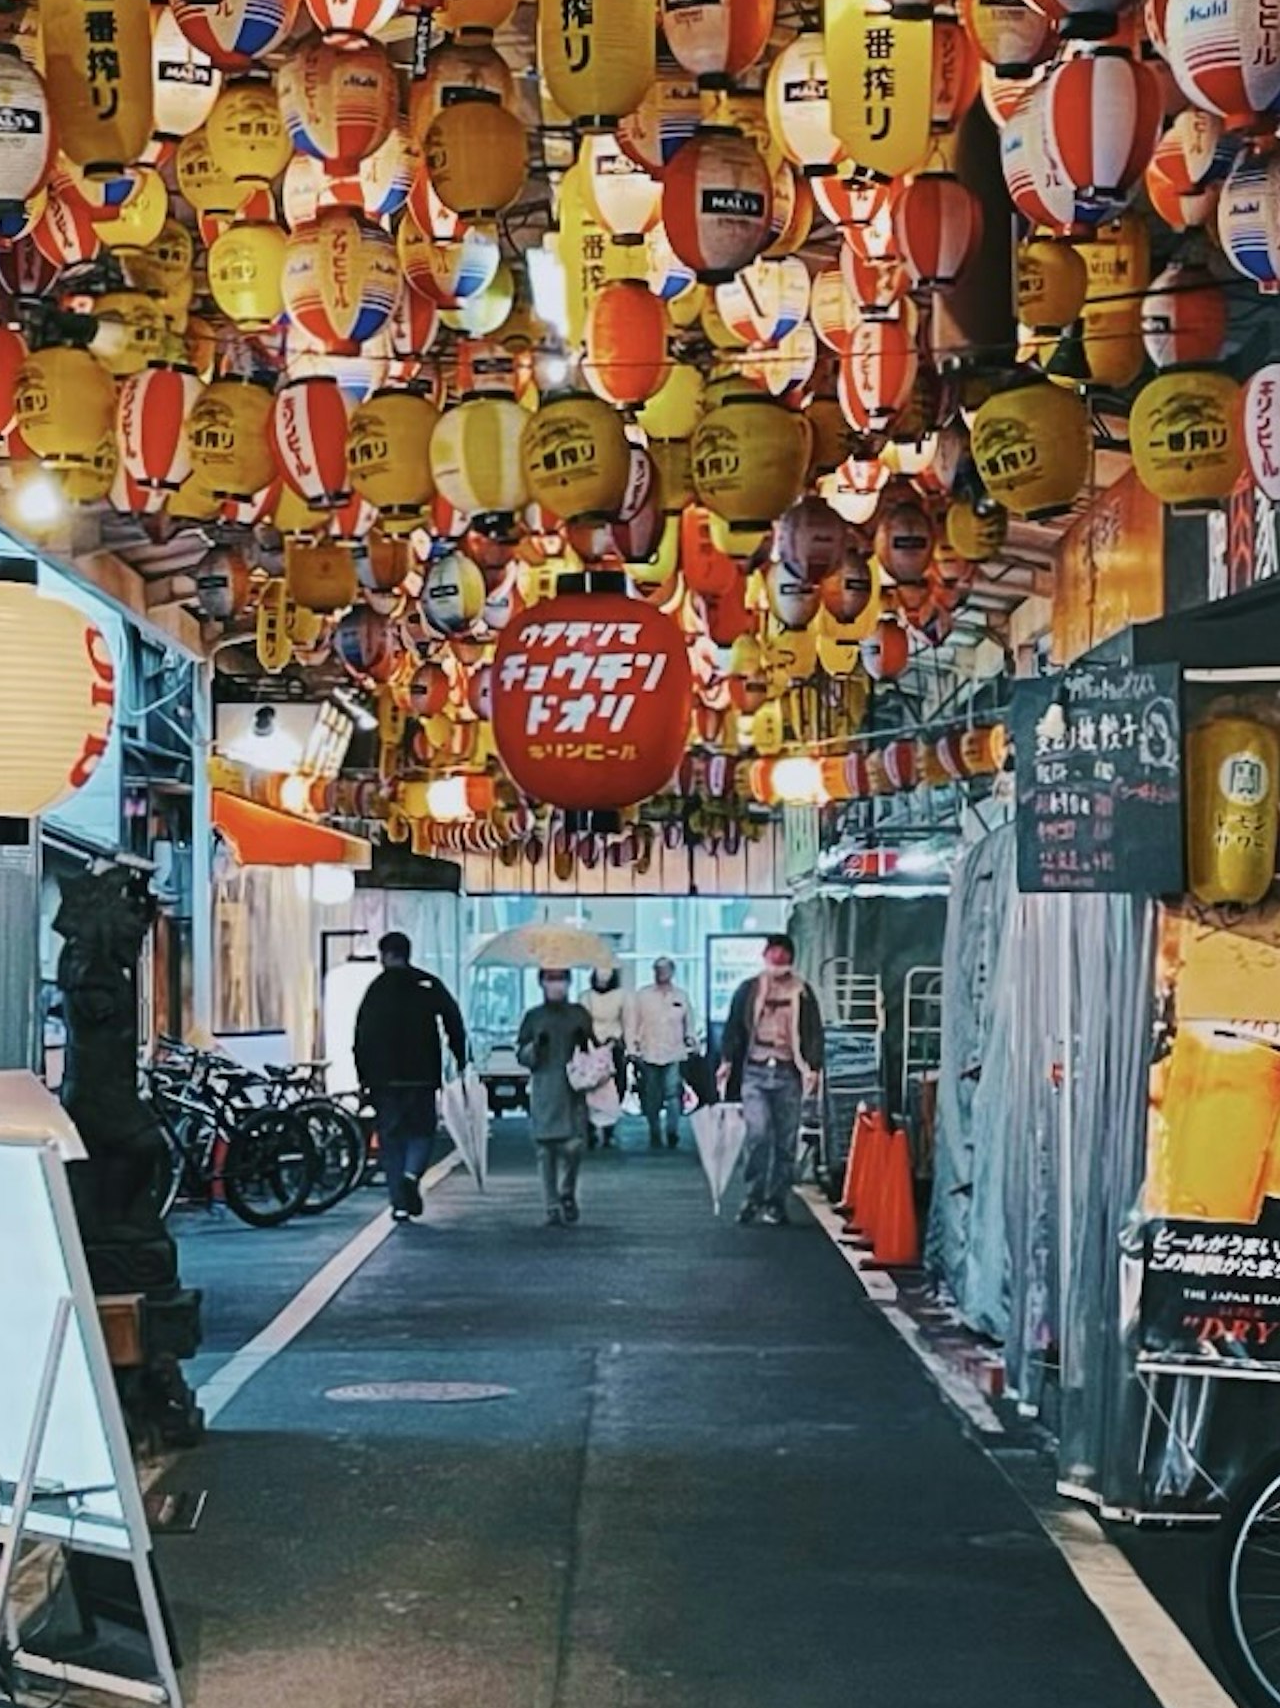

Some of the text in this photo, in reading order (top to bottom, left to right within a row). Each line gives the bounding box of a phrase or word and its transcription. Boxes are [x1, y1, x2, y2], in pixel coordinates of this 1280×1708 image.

[864, 10, 896, 142] 一番搾り
[1149, 428, 1228, 454] 一番搾り
[1257, 380, 1280, 479] キリンビール
[529, 444, 596, 473] 一番搾り
[519, 621, 643, 648] ウラテンマ
[500, 652, 668, 692] チョウチン
[525, 693, 636, 736] ドオリ
[1210, 1290, 1250, 1304] JAPAN
